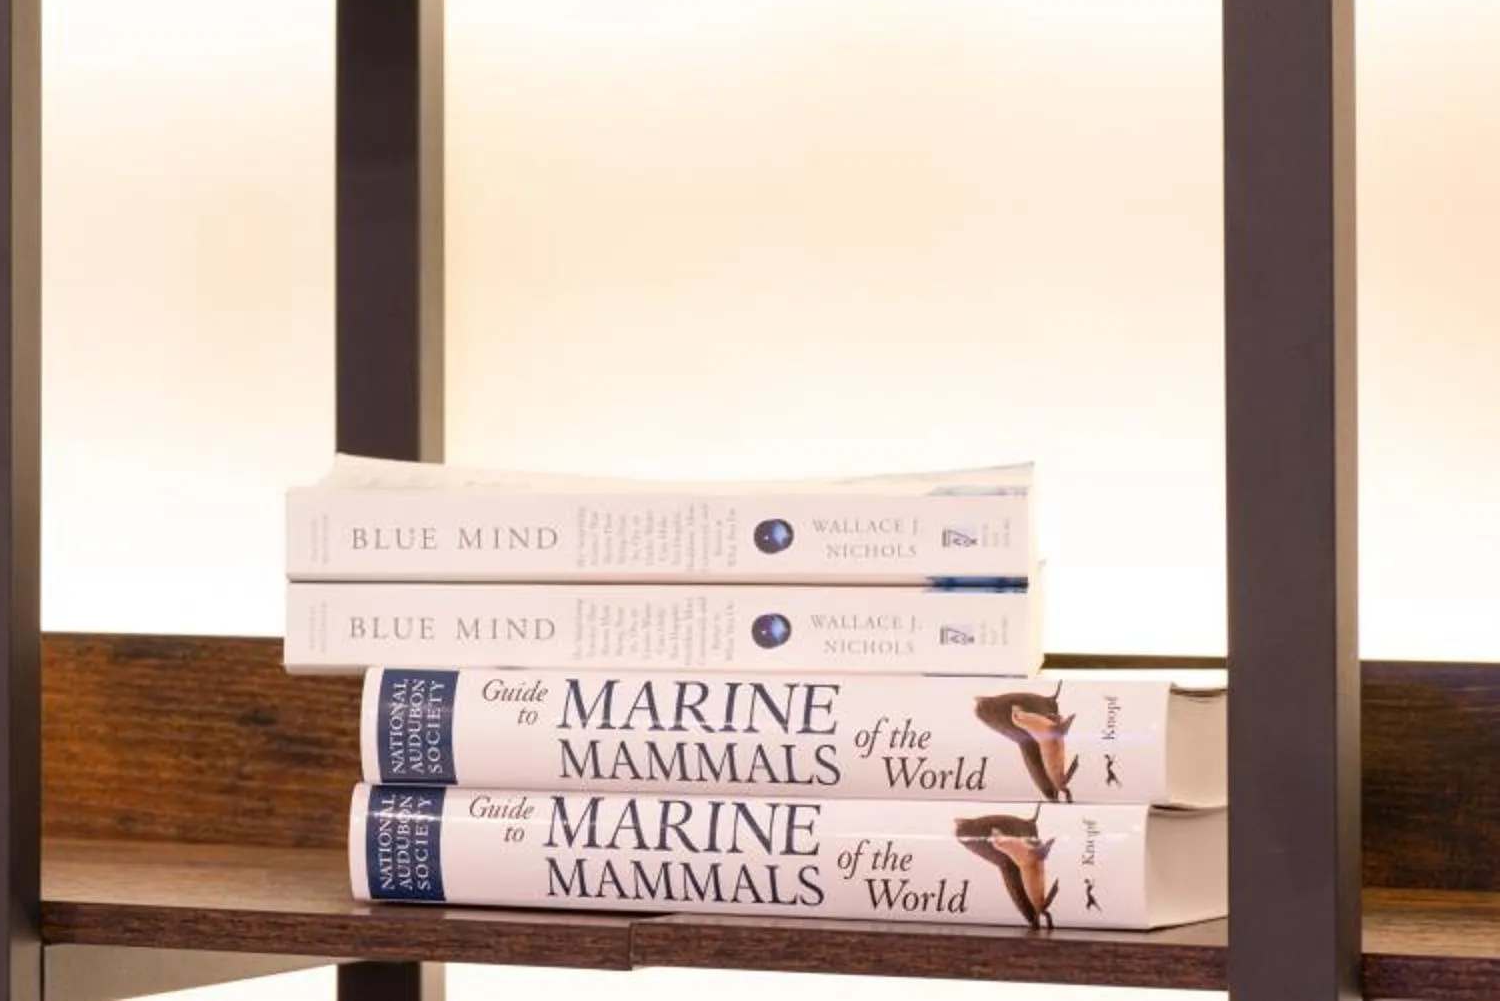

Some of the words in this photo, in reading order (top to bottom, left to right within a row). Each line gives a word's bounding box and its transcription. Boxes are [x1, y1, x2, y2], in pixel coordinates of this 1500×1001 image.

[353, 528, 436, 549] BLUE
[459, 527, 557, 549] MIND
[811, 517, 906, 534] WALLACE
[826, 543, 916, 558] NICHOLS
[351, 617, 434, 639] BLUE
[457, 618, 555, 640] MIND
[809, 614, 903, 631] WALLACE
[824, 639, 914, 655] NICHOLS
[482, 679, 548, 702] Guide
[556, 679, 840, 735] MARINE
[391, 679, 408, 775] NATIONAL
[407, 678, 426, 775] AUDUBON
[427, 680, 446, 775] SOCIETY
[518, 707, 538, 725] to
[1102, 696, 1120, 742] Knopf
[855, 716, 888, 759] of
[886, 718, 931, 750] the
[559, 739, 841, 786] MAMMALS
[882, 756, 988, 791] World
[469, 794, 534, 819] Guide
[379, 794, 397, 891] NATIONAL
[397, 795, 414, 891] AUDUBON
[504, 822, 525, 843] to
[543, 796, 820, 857] MARINE
[837, 839, 867, 882] of
[870, 837, 914, 873] the
[546, 858, 824, 907] MAMMALS
[865, 879, 968, 913] World
